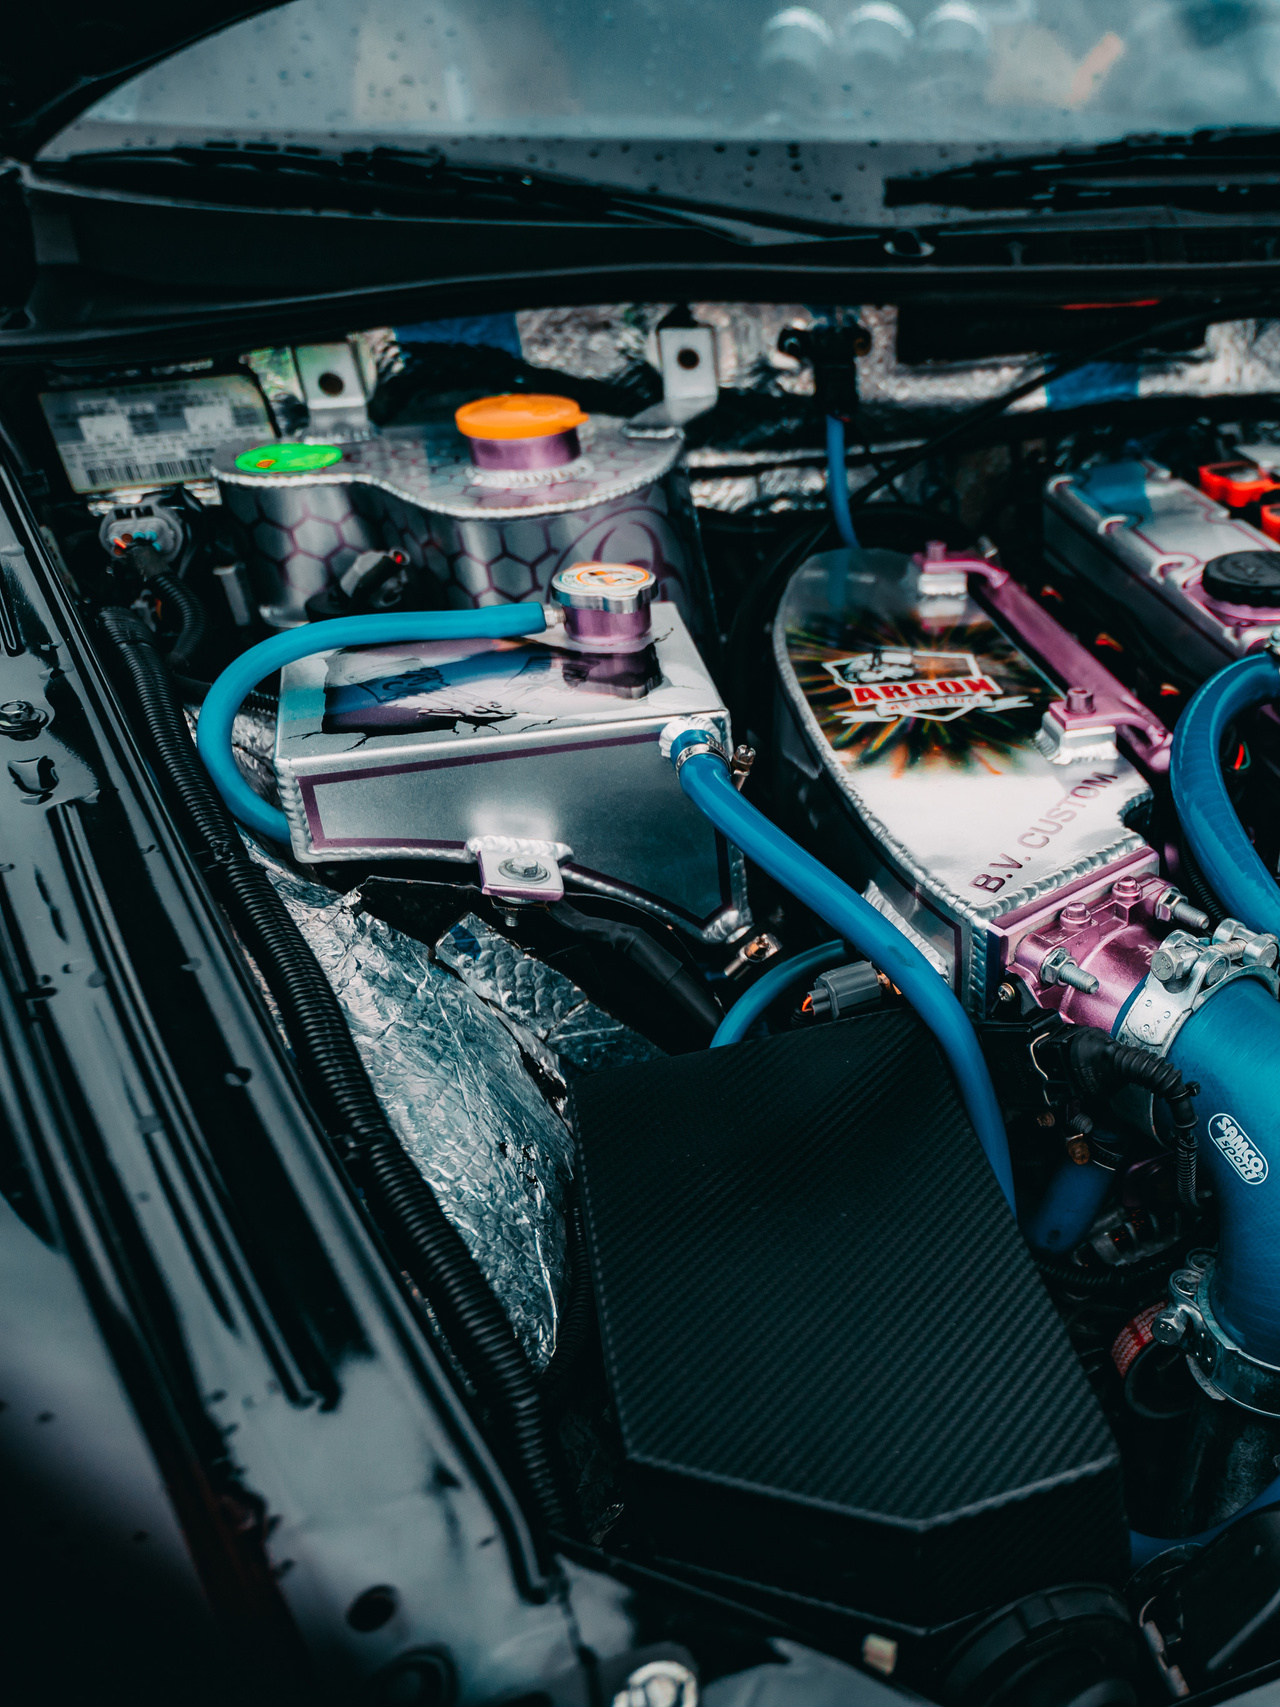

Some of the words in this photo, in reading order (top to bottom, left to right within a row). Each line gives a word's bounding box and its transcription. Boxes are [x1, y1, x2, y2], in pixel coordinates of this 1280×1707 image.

[853, 678, 996, 704] ARGON
[884, 697, 981, 712] WELDING
[968, 852, 1031, 894] B.V.
[1017, 772, 1118, 849] CUSTOM
[1221, 1140, 1253, 1176] sport
